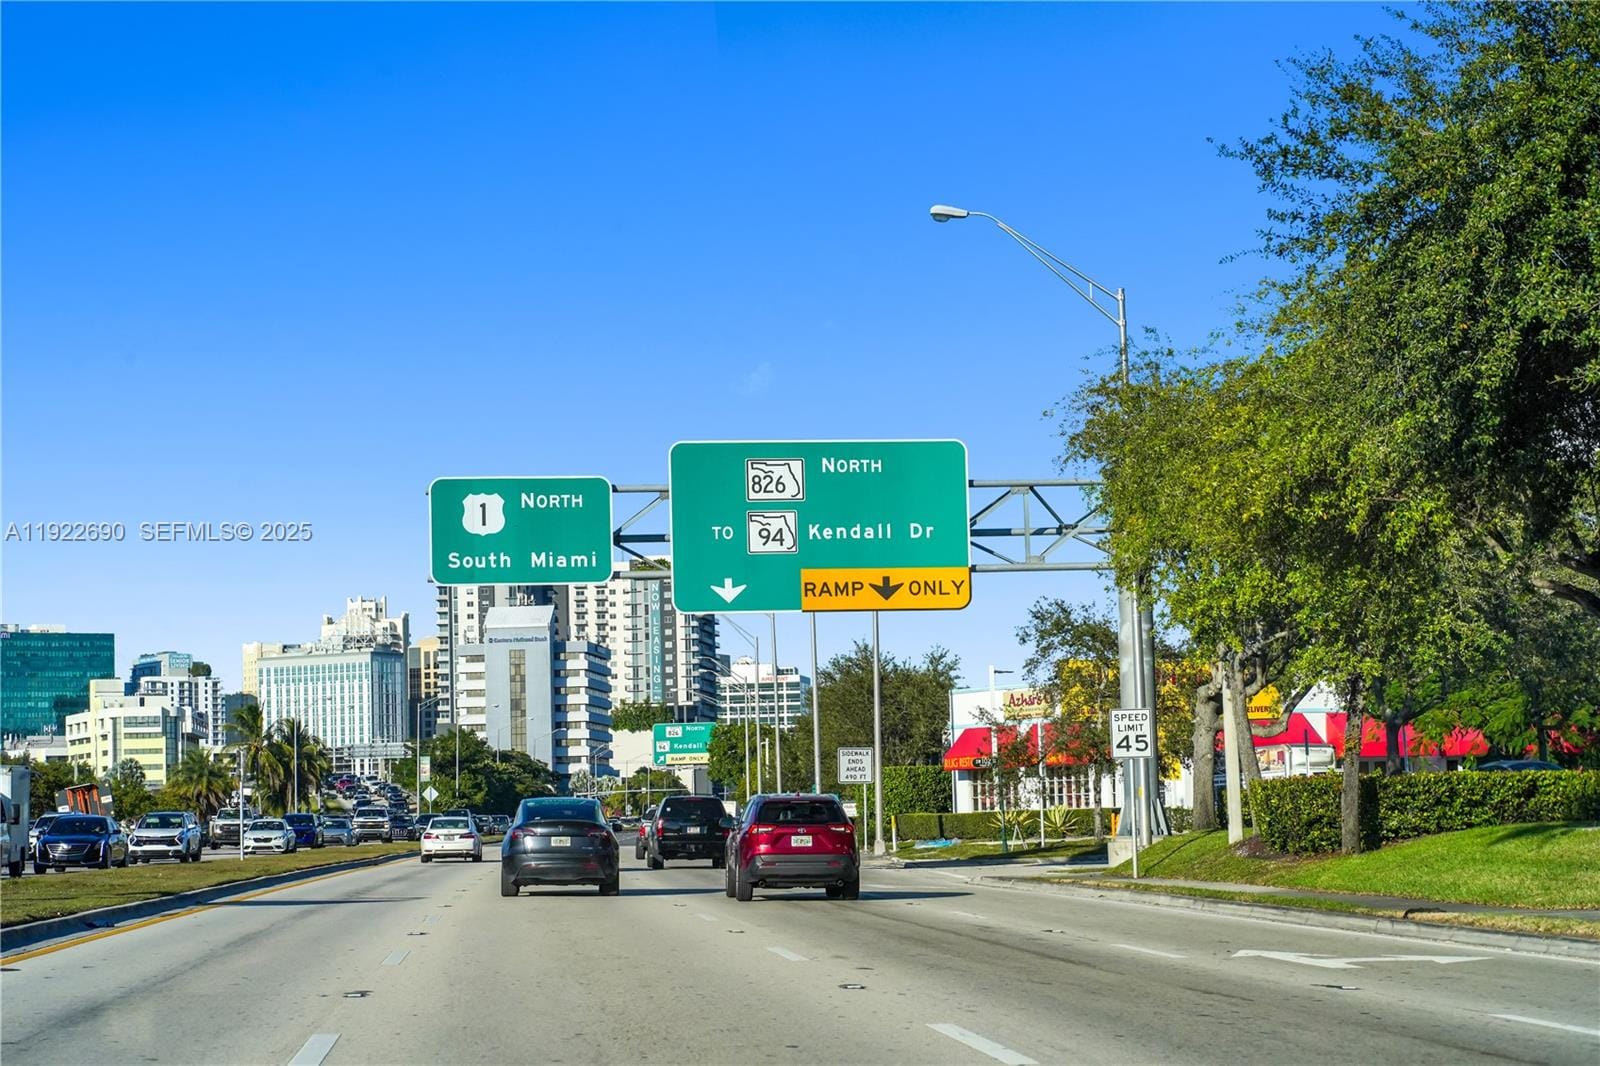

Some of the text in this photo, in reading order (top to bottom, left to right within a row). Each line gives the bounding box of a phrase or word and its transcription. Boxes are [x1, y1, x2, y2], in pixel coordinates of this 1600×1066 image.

[821, 457, 882, 473] NORTH
[752, 475, 786, 494] 826
[520, 492, 583, 509] NORTH
[479, 502, 487, 527] 1
[712, 523, 934, 546] TO 94 Kendall Dr
[448, 551, 597, 569] South Miami
[651, 583, 660, 610] NOW
[804, 580, 966, 597] RAMP ONLY
[652, 616, 661, 684] LEASING
[1114, 713, 1148, 722] SPEED
[1117, 724, 1144, 732] LIMIT
[1116, 734, 1149, 752] 45
